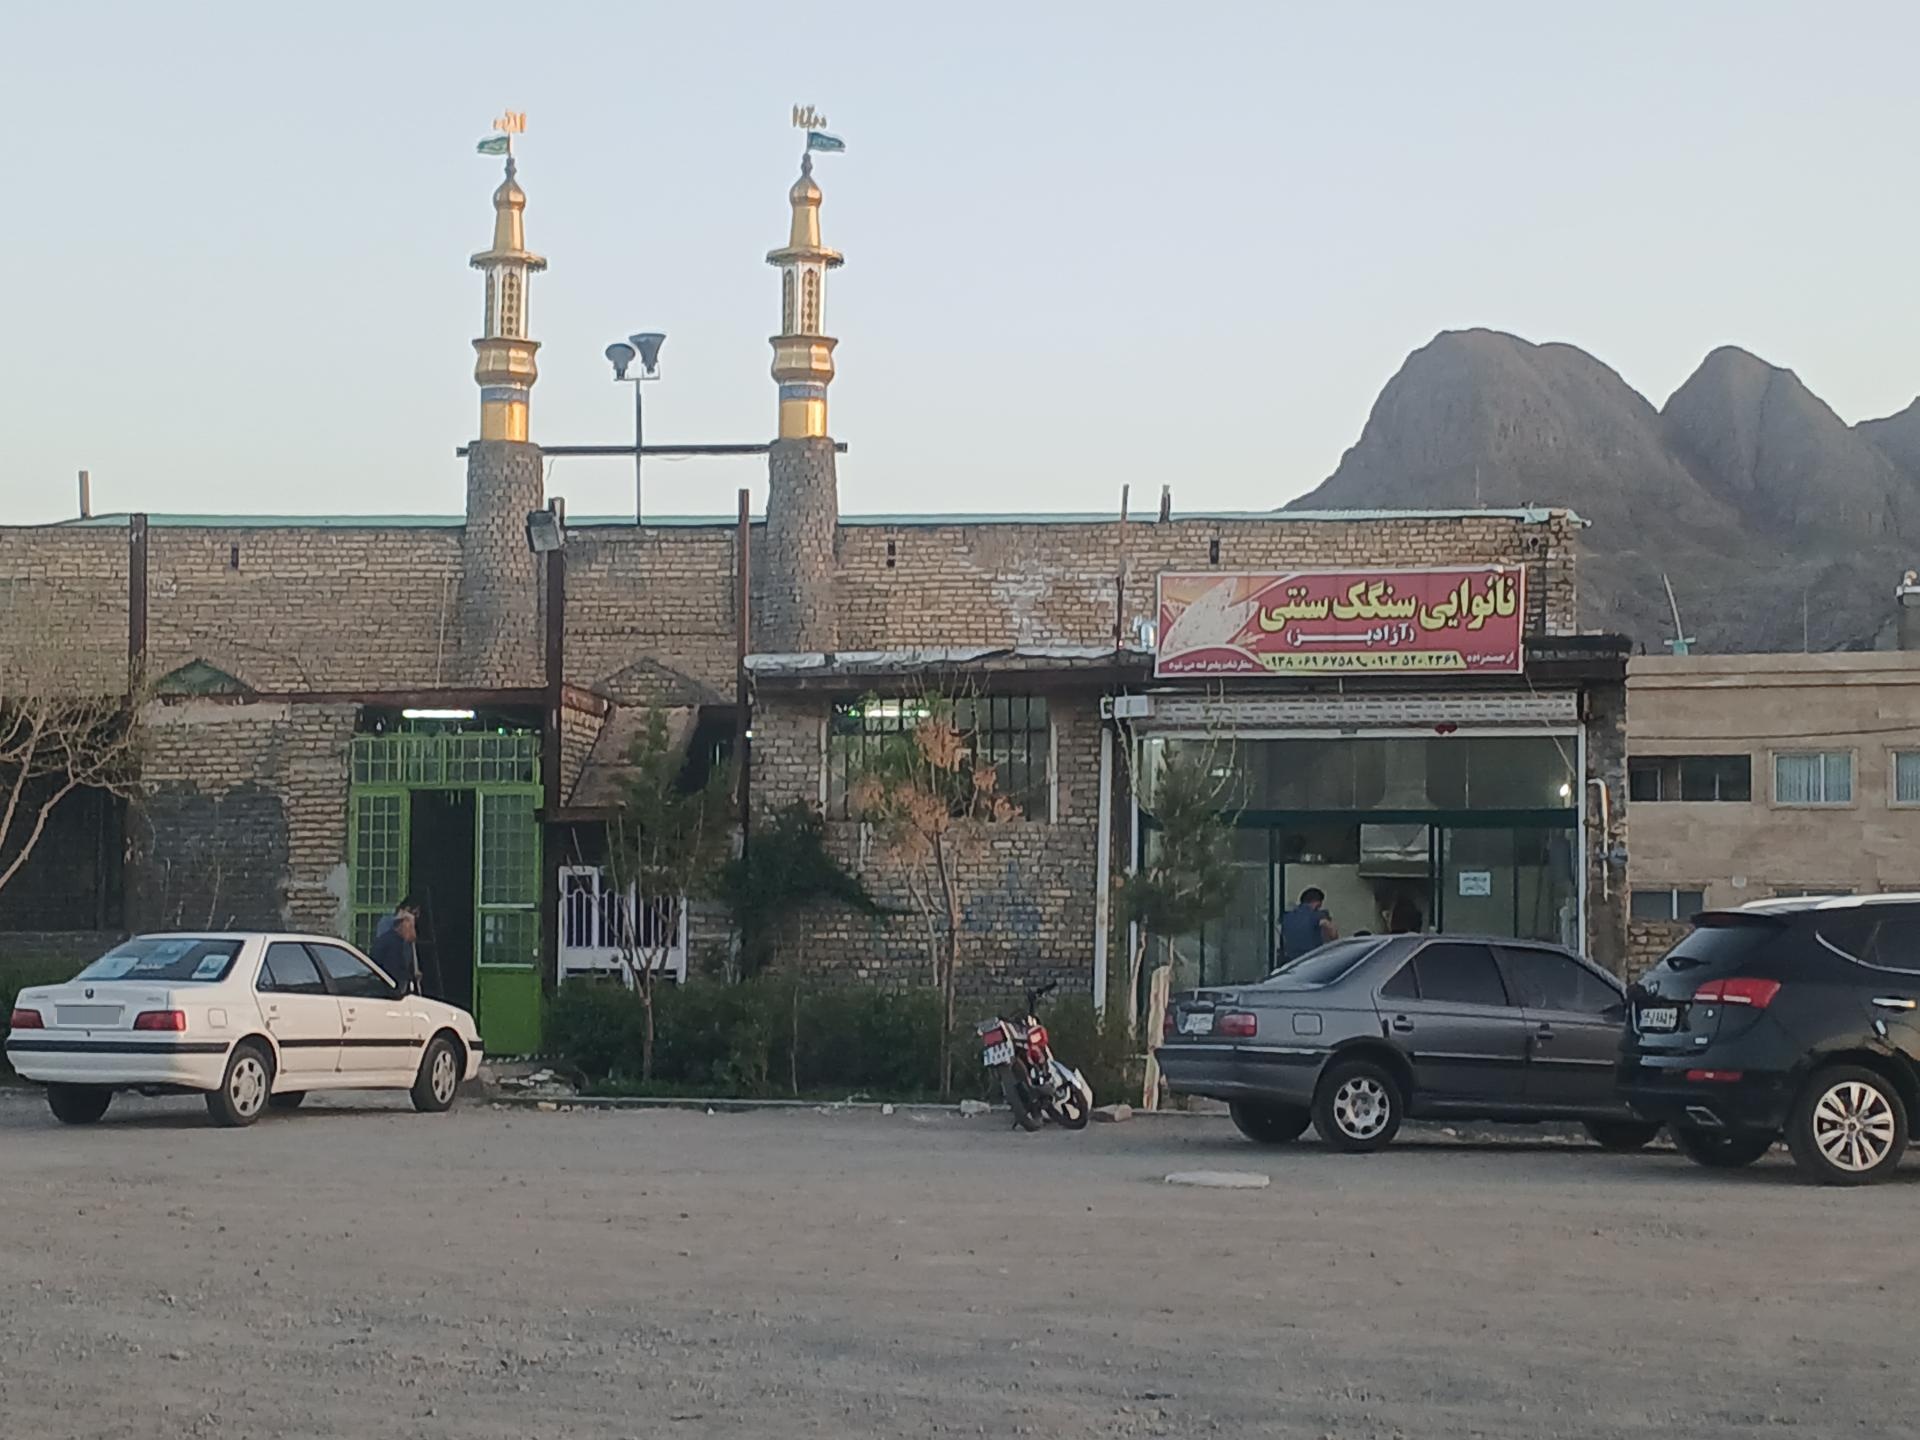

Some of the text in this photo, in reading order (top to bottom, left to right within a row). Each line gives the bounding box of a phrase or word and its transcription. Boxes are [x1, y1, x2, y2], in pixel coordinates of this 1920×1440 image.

[1259, 574, 1516, 632] نانوایی سنگک سنتی
